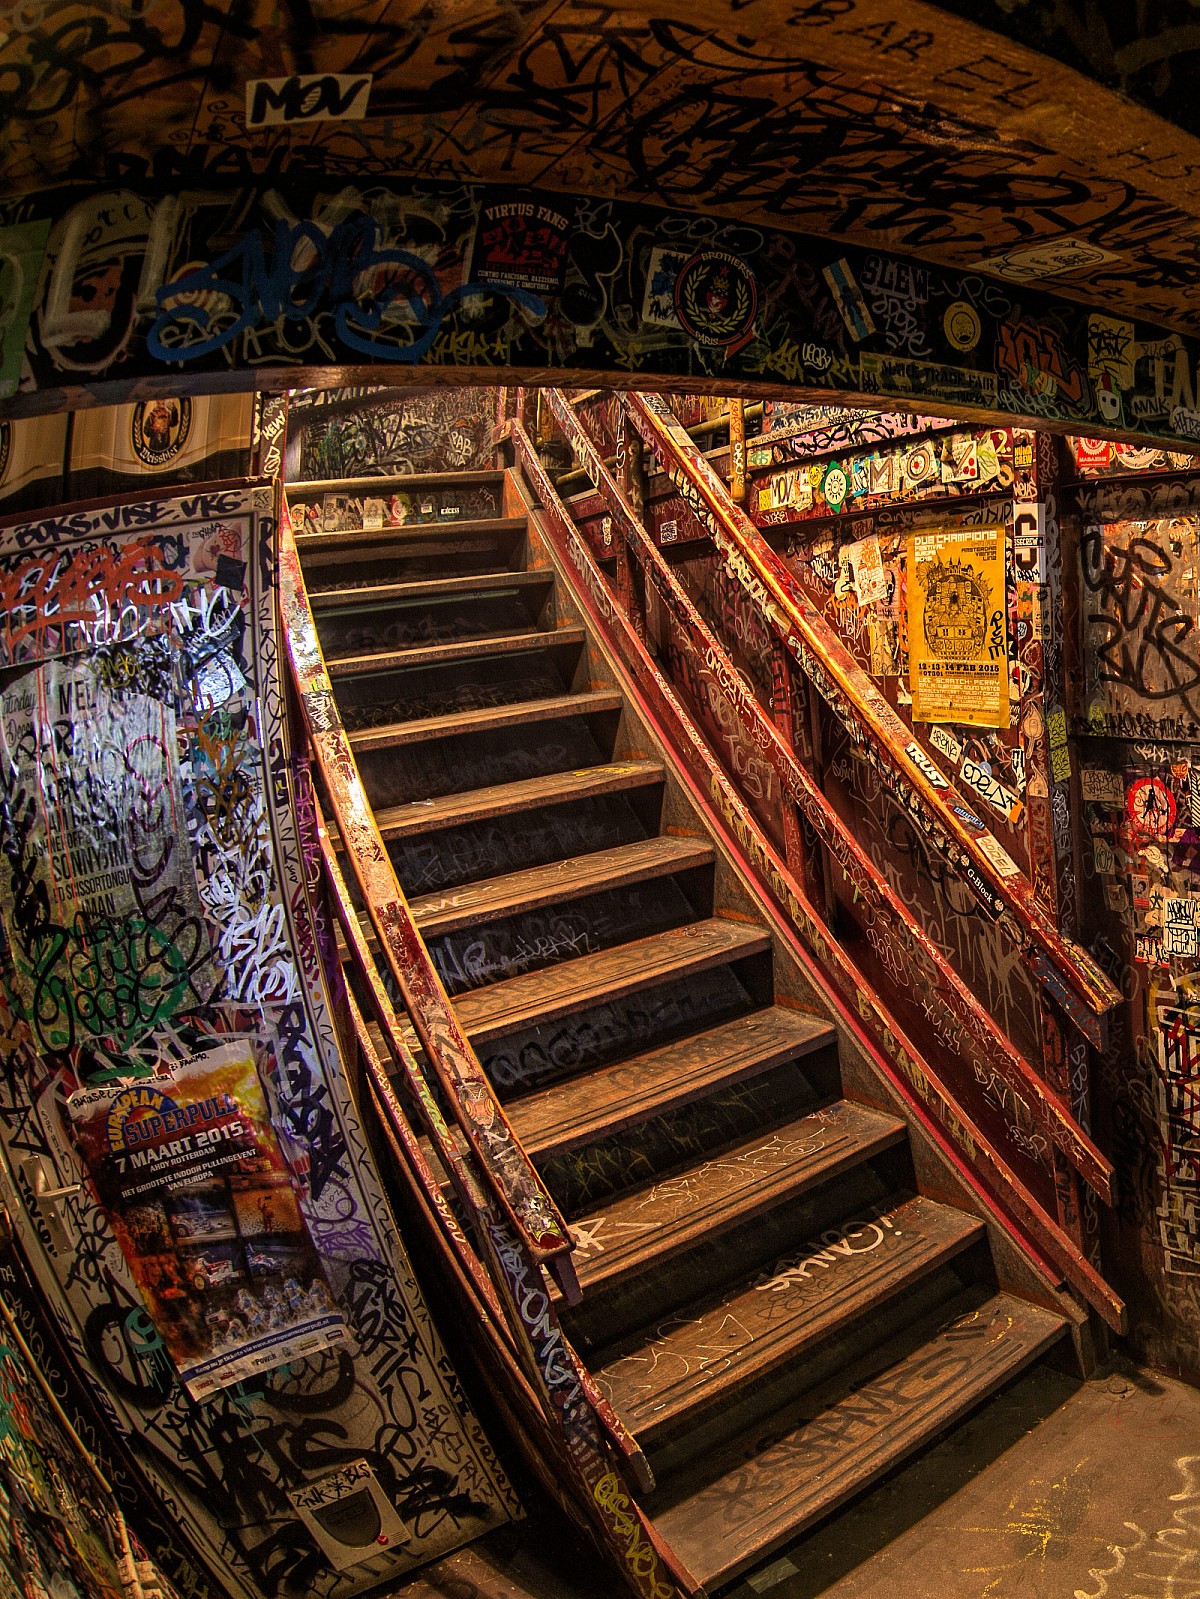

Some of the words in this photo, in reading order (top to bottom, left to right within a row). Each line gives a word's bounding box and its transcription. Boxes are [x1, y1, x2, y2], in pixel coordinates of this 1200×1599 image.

[485, 203, 534, 221] VIRTUS
[536, 206, 570, 231] FANS
[701, 251, 753, 281] BROTHERS
[694, 331, 719, 346] PARIS
[968, 373, 995, 391] FAIR
[139, 445, 180, 467] Weissbier
[102, 501, 173, 530] VISE
[915, 535, 934, 545] DUB
[937, 531, 997, 543] CHAMPIONS
[906, 744, 948, 788] TRUST
[967, 868, 993, 904] G-Block
[125, 1093, 238, 1145] SUPERPULL
[115, 1158, 125, 1173] 7
[130, 1136, 191, 1169] MAART
[195, 1121, 244, 1148] 2015
[150, 1160, 169, 1172] AHOY
[171, 1146, 216, 1166] ROTTERDAM
[122, 1188, 135, 1198] HET
[137, 1174, 173, 1193] GROOTSTE
[173, 1165, 201, 1180] INDOOR
[202, 1148, 257, 1170] PULLINGEVENT
[167, 1179, 183, 1191] VAN
[184, 1170, 214, 1186] EUROPA
